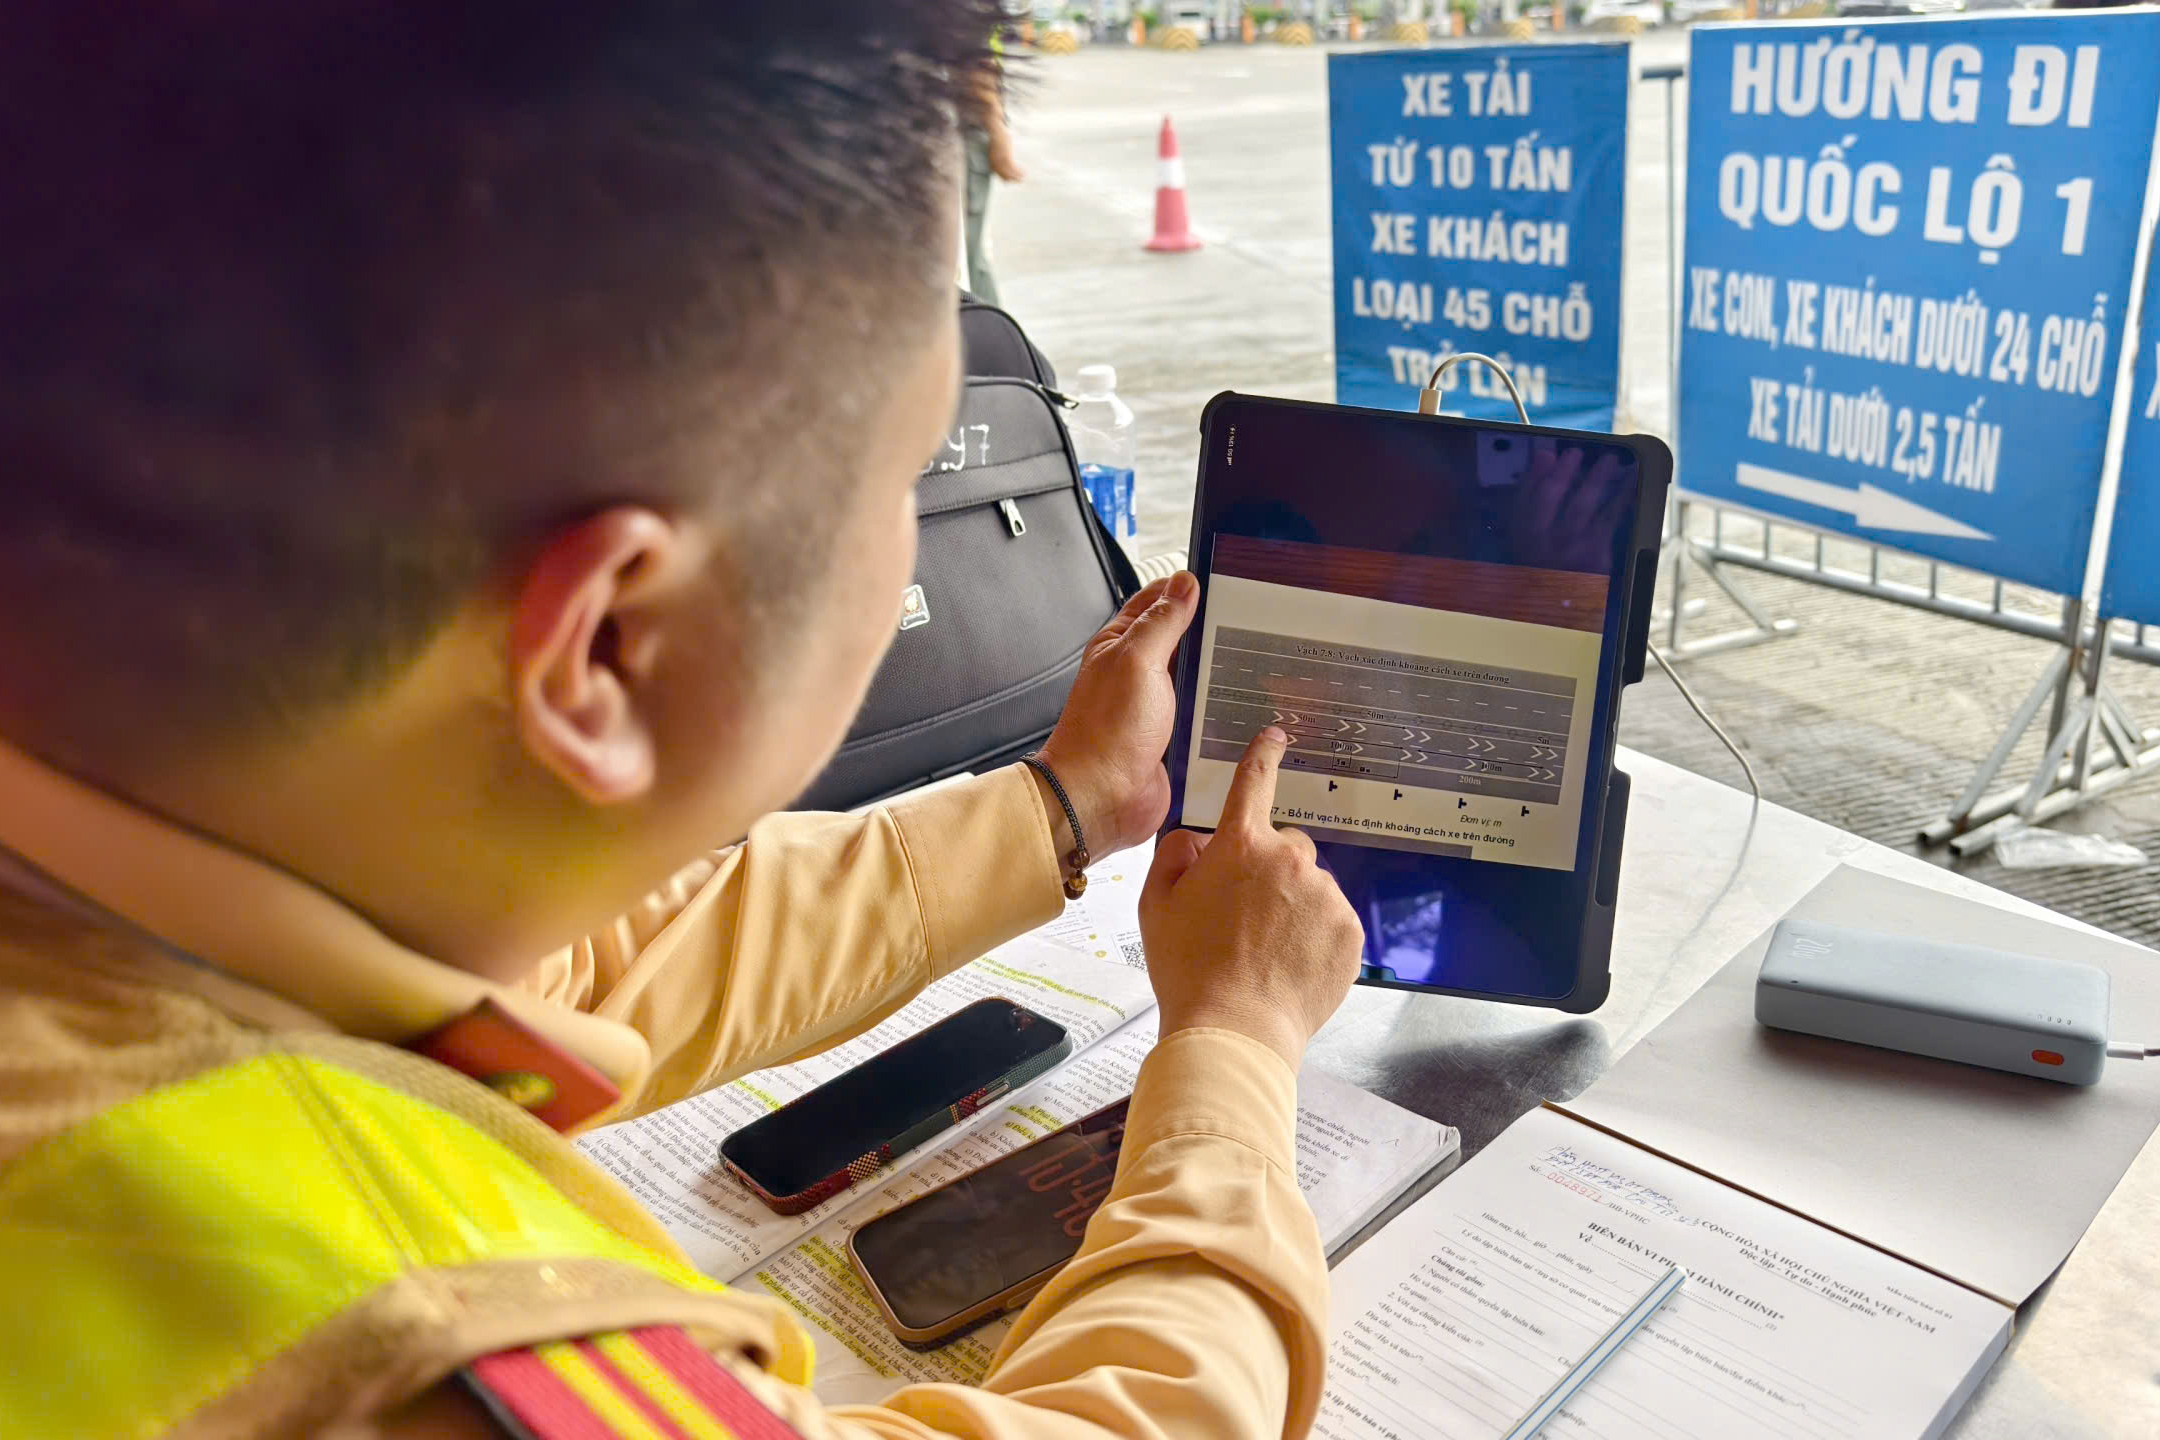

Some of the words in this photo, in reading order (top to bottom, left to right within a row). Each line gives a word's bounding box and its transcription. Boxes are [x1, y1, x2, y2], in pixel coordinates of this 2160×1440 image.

[1402, 73, 1451, 117] XE
[1464, 58, 1530, 116] TẢI
[1730, 29, 1983, 124] HƯỚNG
[2008, 43, 2100, 128] ĐI
[1368, 136, 1418, 187] TỪ
[1427, 146, 1473, 188] 10
[1485, 131, 1572, 191] TẤN
[1719, 134, 1901, 237] QUỐC
[1924, 154, 2023, 265] LỘ
[2056, 177, 2092, 256] 1
[1370, 213, 1415, 254] XE
[1428, 210, 1568, 267] KHÁCH
[1353, 278, 1432, 331] LOẠI
[1443, 288, 1490, 331] 45
[1504, 282, 1592, 341] CHỖ
[1689, 266, 1721, 331] XE
[1724, 271, 1776, 351] CON,
[1784, 279, 1818, 349] XE
[1822, 276, 1913, 367] KHÁCH
[1916, 288, 1987, 381] DƯỚI
[1990, 309, 2030, 385] 24
[2036, 293, 2109, 398] CHỖ
[1388, 340, 1458, 391] TRỞ
[1469, 351, 1547, 406] LÊN
[1748, 376, 1780, 443] XE
[1786, 366, 1824, 454] TẢI
[1827, 385, 1889, 468] DƯỚI
[1893, 406, 1938, 483] 2,5
[1945, 396, 2001, 494] TẤN
[1459, 776, 1481, 785] 200m
[1588, 1221, 1615, 1240] BIÊN
[1616, 1235, 1643, 1253] BẢN
[1644, 1248, 1658, 1260] VI
[1659, 1255, 1695, 1278] PHM
[1696, 1271, 1734, 1298] HÀNH
[1702, 1220, 1734, 1239] CỘNG
[1874, 1300, 1902, 1317] VIỆT
[1904, 1313, 1936, 1334] NAM
